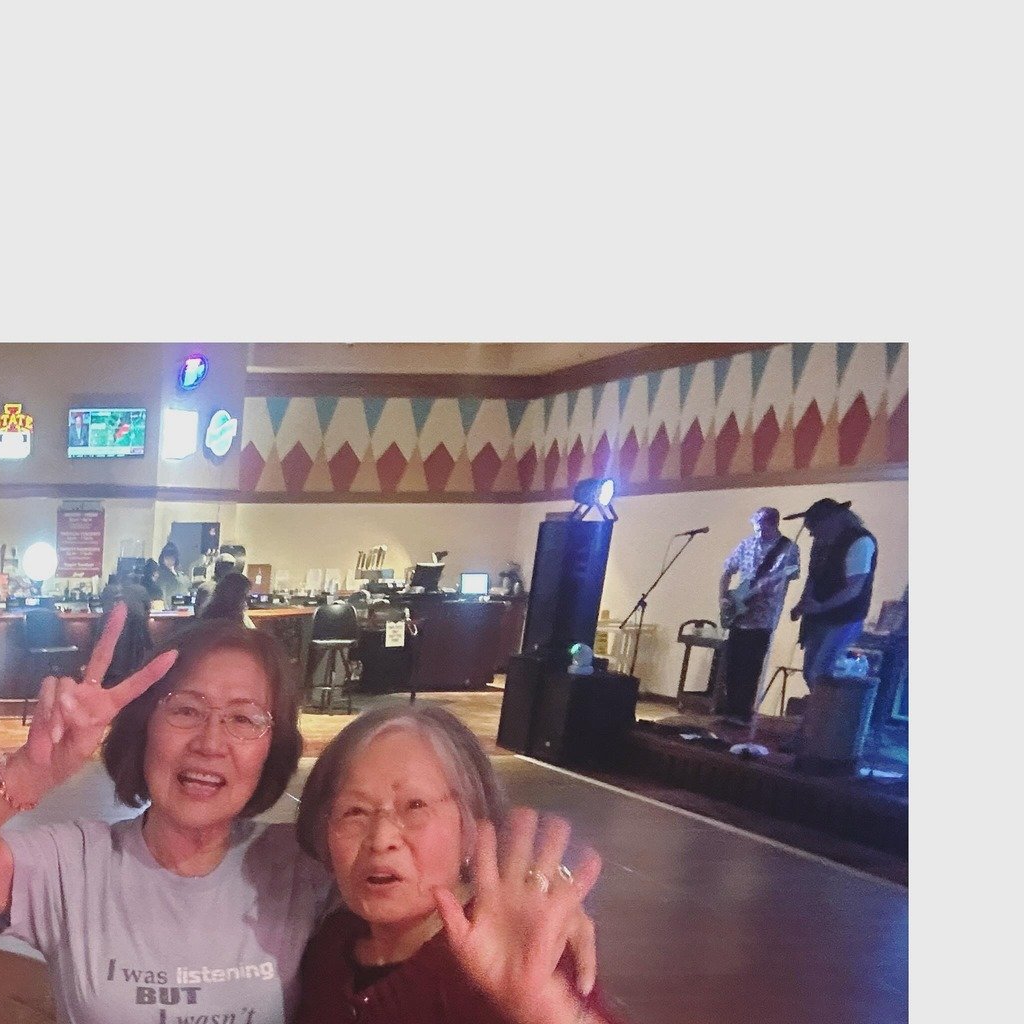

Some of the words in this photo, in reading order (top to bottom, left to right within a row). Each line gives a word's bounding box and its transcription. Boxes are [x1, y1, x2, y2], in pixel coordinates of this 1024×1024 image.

[107, 958, 116, 981] I
[122, 967, 168, 984] was
[176, 961, 274, 984] listening
[135, 986, 201, 1005] BUT
